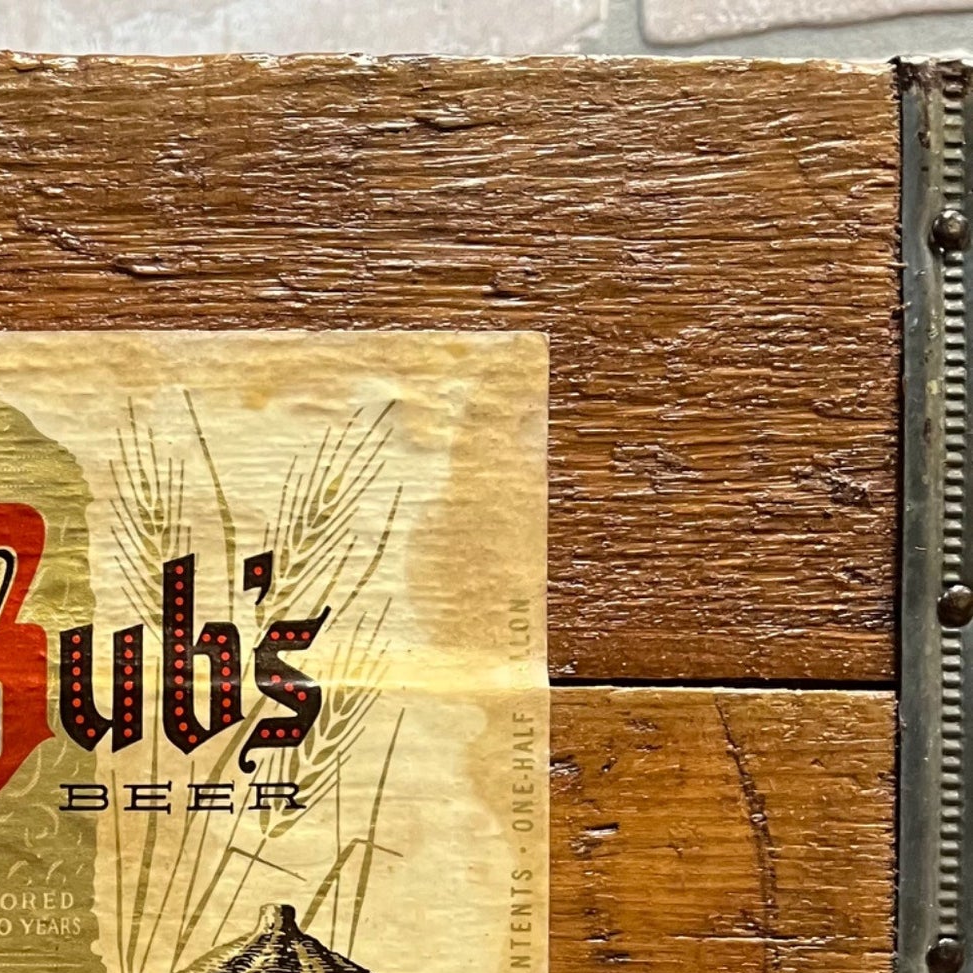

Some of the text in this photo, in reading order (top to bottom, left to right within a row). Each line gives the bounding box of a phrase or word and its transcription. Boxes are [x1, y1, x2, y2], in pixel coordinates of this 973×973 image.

[511, 712, 534, 833] ONE-HALF
[59, 780, 307, 815] BEER
[19, 917, 81, 936] YEARS
